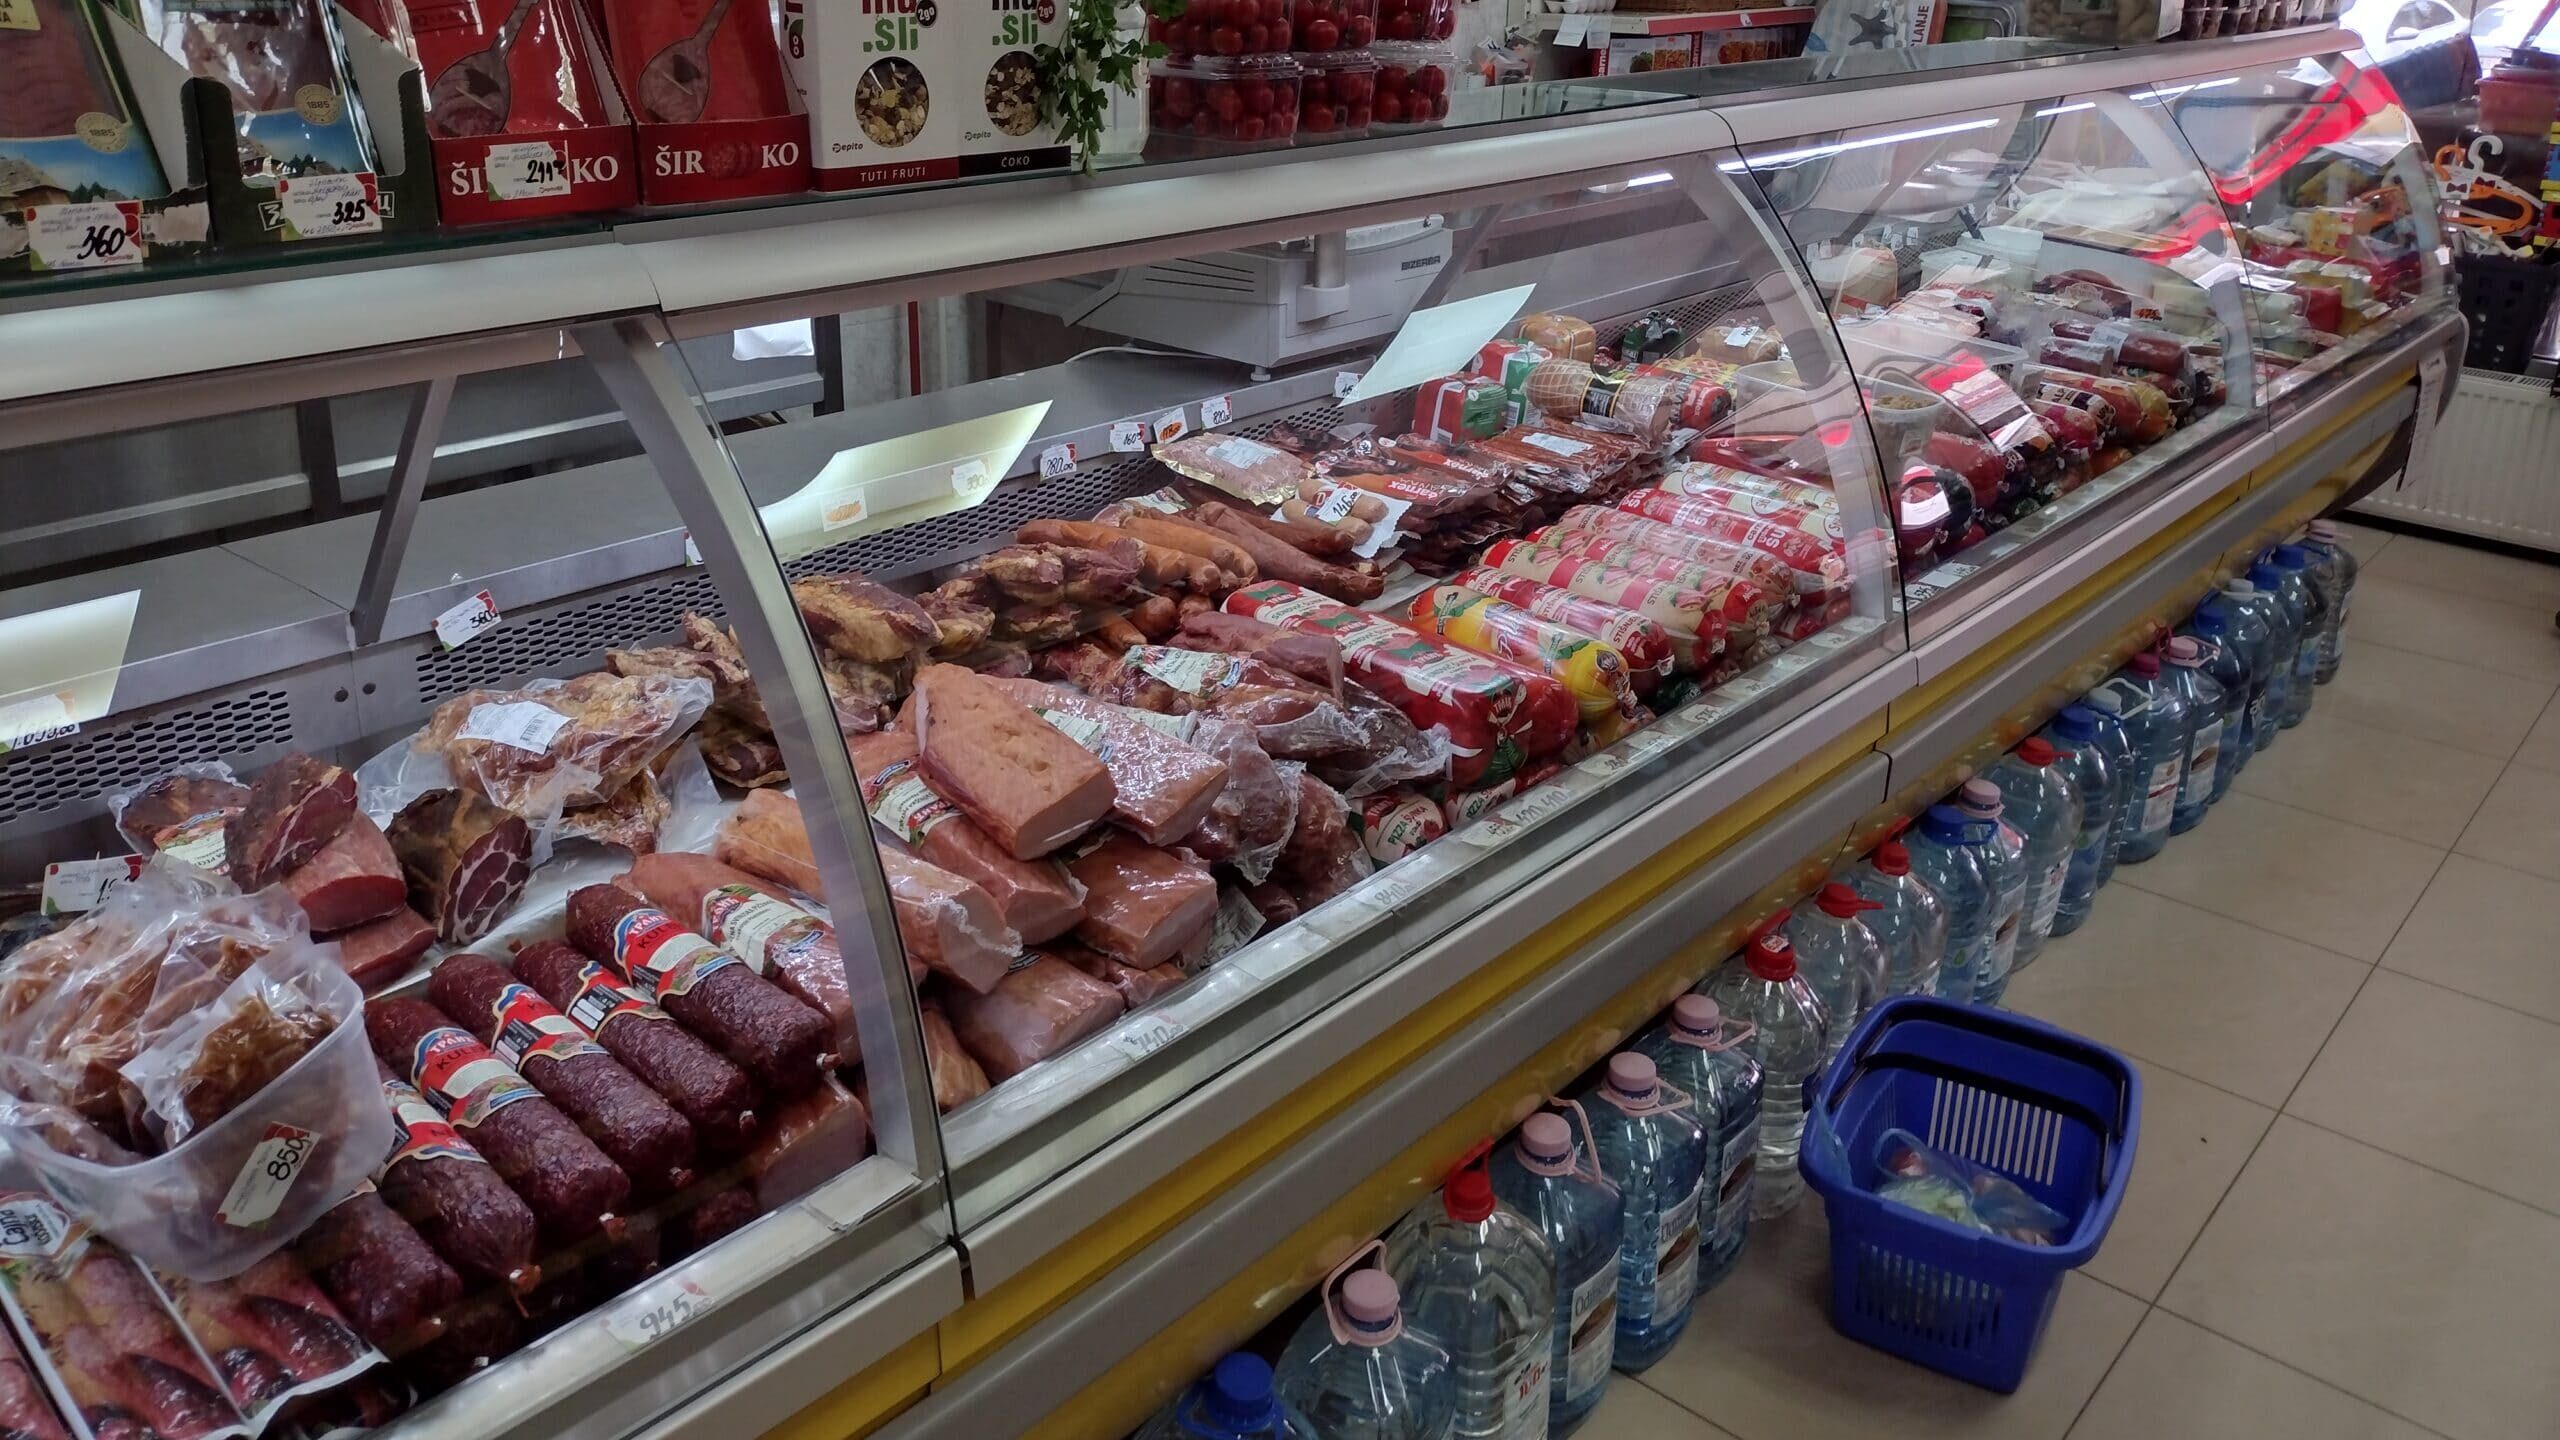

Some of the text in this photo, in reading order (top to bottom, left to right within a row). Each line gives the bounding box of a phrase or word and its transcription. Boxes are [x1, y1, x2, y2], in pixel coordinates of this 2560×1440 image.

[918, 6, 935, 21] 2go
[1039, 5, 1054, 19] 2go
[307, 100, 331, 109] 1885
[831, 141, 864, 154] Pepito
[655, 142, 800, 176] ŠIR KO
[571, 155, 619, 185] KO
[860, 166, 927, 183] TUTI FRUTI
[1387, 820, 1409, 847] PIZZA
